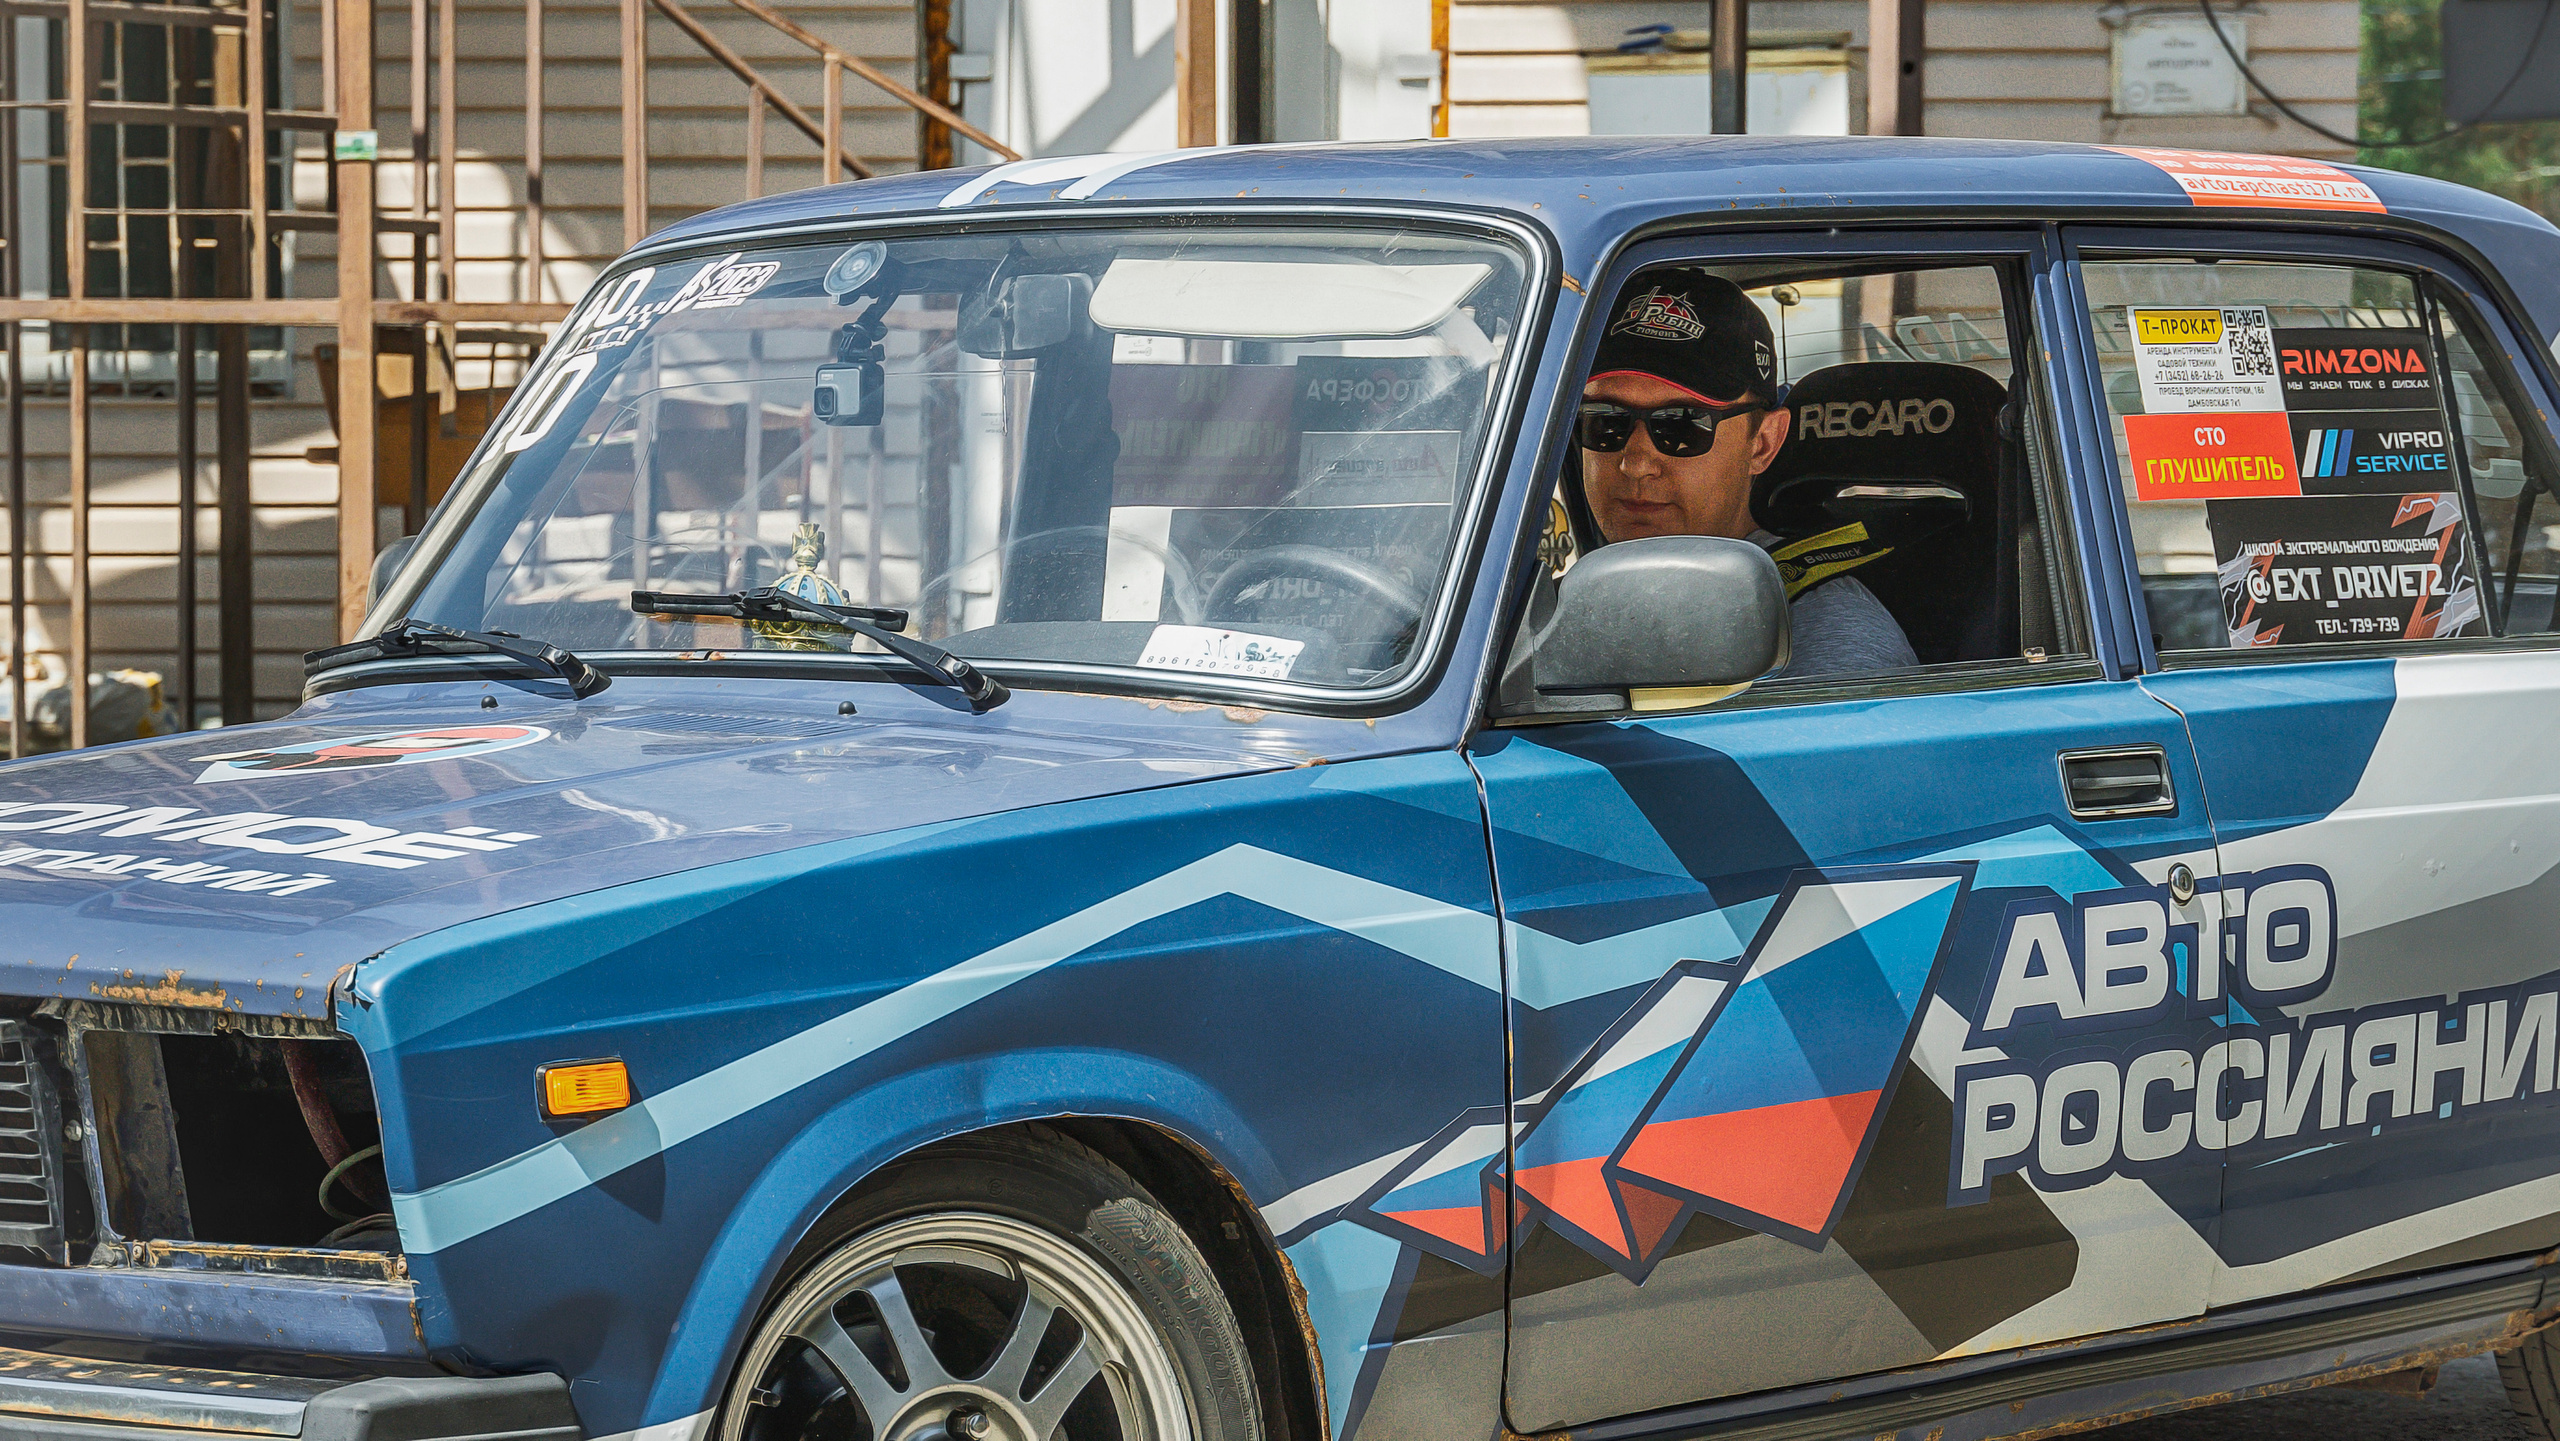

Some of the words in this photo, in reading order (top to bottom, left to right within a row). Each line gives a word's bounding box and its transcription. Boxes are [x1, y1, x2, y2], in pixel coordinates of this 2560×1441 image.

[2186, 176, 2371, 199] avtozapchasti72.ru
[707, 263, 772, 297] 2023
[2141, 318, 2217, 335] Т-ПРОКАТ
[2147, 347, 2171, 355] АРЕНДА
[2173, 346, 2218, 355] ИНСТРУМЕНТА
[2219, 346, 2223, 354] И
[2157, 358, 2187, 368] САДОВОЙ
[2188, 359, 2217, 367] ТЕХНИКИ
[2281, 348, 2427, 374] RIMZONA
[2154, 371, 2163, 381] +7
[2165, 370, 2189, 381] (3452)
[2190, 370, 2225, 381] 68-26-26
[2287, 381, 2304, 390] МЫ
[2309, 380, 2343, 390] ЗНАЕМ
[2347, 380, 2373, 389] ТОЛК
[2379, 380, 2386, 389] В
[2391, 379, 2431, 389] ДИСКАХ
[2159, 387, 2184, 396] ПРОЕЗД
[2185, 386, 2231, 395] ВОРОНИНСКИЕ
[2231, 386, 2253, 395] ГОРКИ,
[2188, 399, 2229, 408] ДАМБОВСКАЯ
[1798, 397, 1956, 441] RECARO
[2194, 426, 2226, 447] СТО
[2377, 430, 2445, 450] VIPRO
[2145, 455, 2286, 484] ГЛУШИТЕЛЬ
[2355, 453, 2448, 473] SERVICE
[1803, 547, 1865, 565] Beltenick
[2244, 541, 2285, 556] ШКОЛА
[2285, 539, 2380, 555] ЭКСТРЕМАЛЬНОГО
[2381, 537, 2440, 553] ВОЖДЕНИЯ
[2246, 563, 2447, 608] @EXT_DRIVE72
[2315, 618, 2348, 635] ТЕЛ.:
[2349, 616, 2400, 633] 739-739
[0, 801, 543, 870] ОМОЁ
[0, 848, 337, 897] ПАНИЙ
[1981, 878, 2331, 1032] АВТО
[1959, 990, 2560, 1191] РОССИЯНИ
